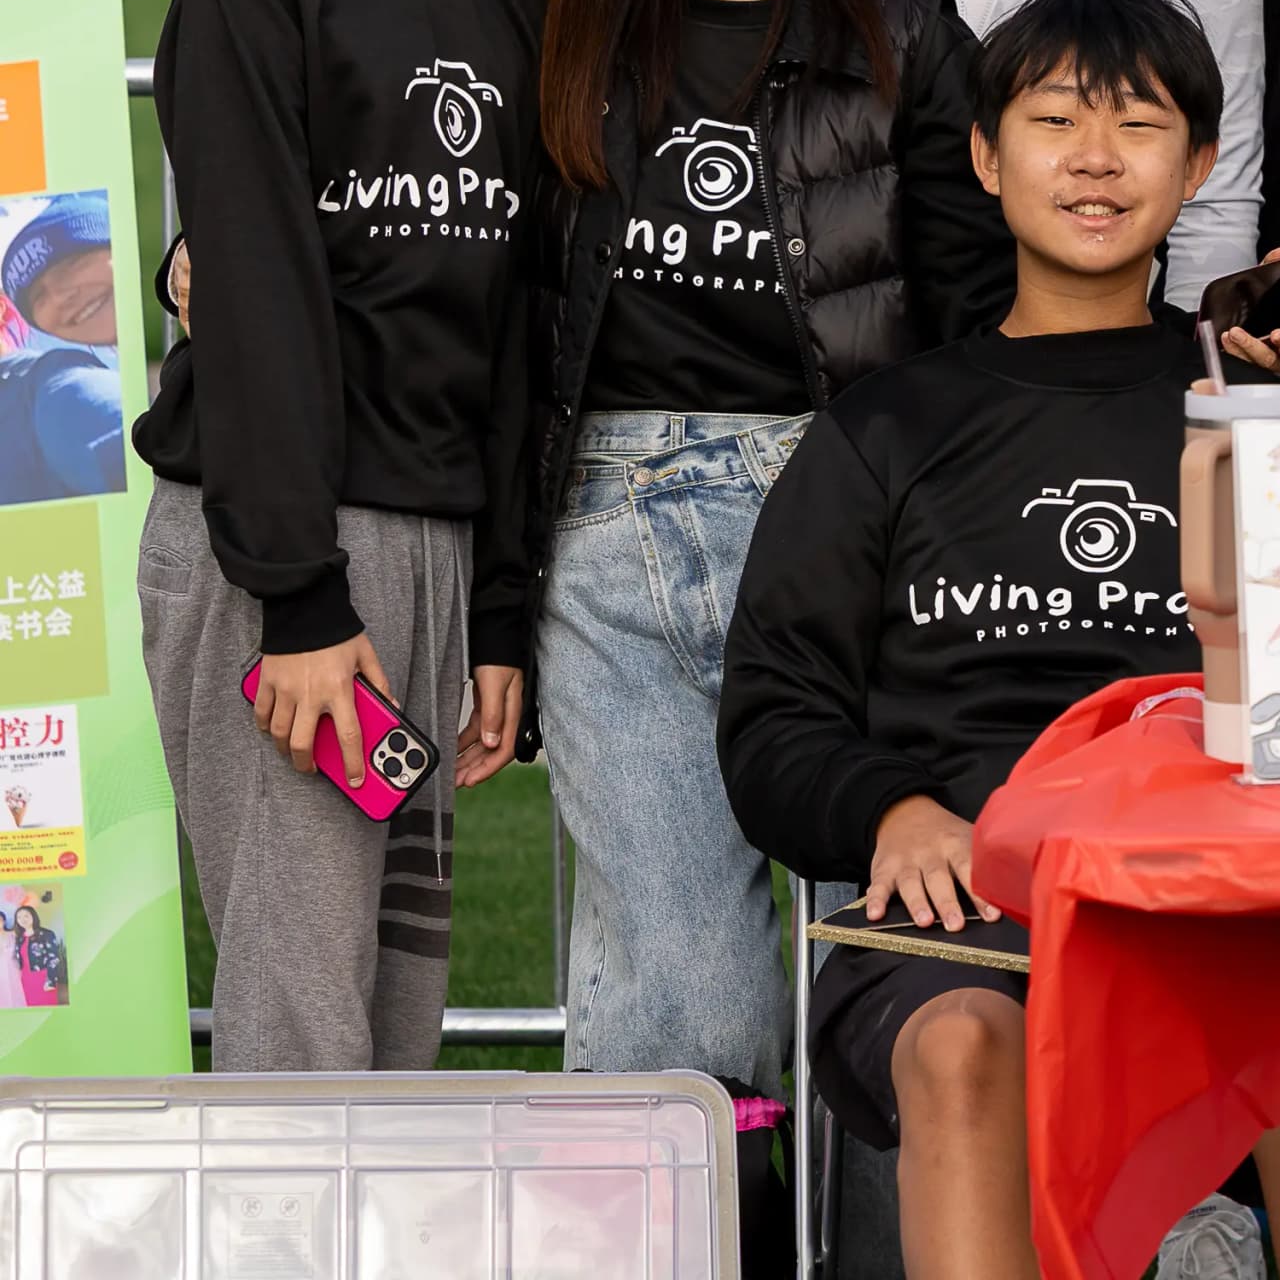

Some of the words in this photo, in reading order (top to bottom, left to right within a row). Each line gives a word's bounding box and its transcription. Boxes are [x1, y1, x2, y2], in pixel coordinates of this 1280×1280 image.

[317, 165, 450, 217] Living
[908, 574, 1072, 625] Living
[1099, 580, 1190, 615] Pro
